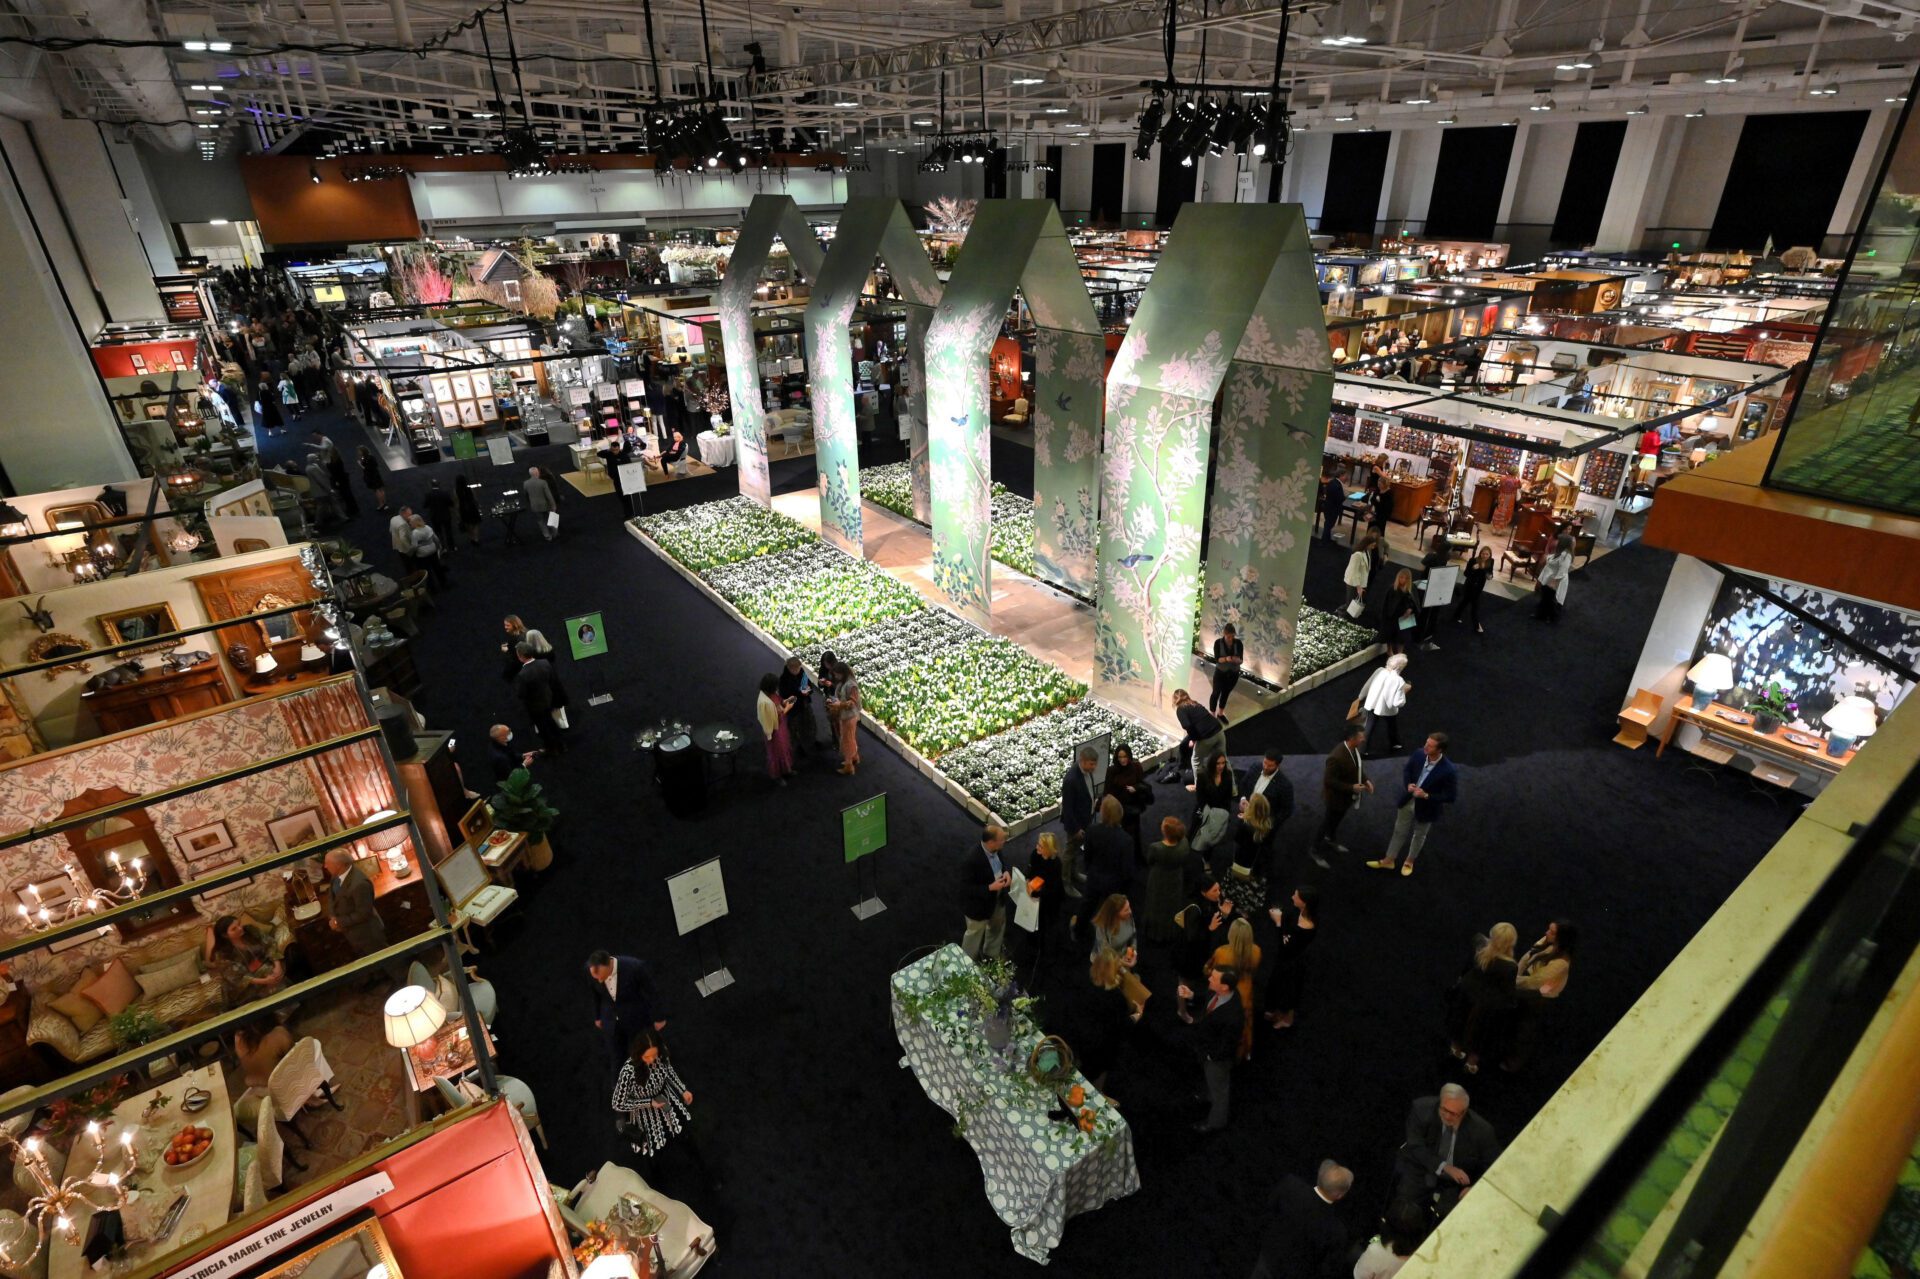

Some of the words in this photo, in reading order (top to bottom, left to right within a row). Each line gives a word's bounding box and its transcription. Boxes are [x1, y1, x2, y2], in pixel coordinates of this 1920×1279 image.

[185, 1259, 228, 1279] TRICIA
[227, 1240, 264, 1264] MARIE
[263, 1228, 288, 1245] FINE
[290, 1203, 334, 1232] JEWELRY
